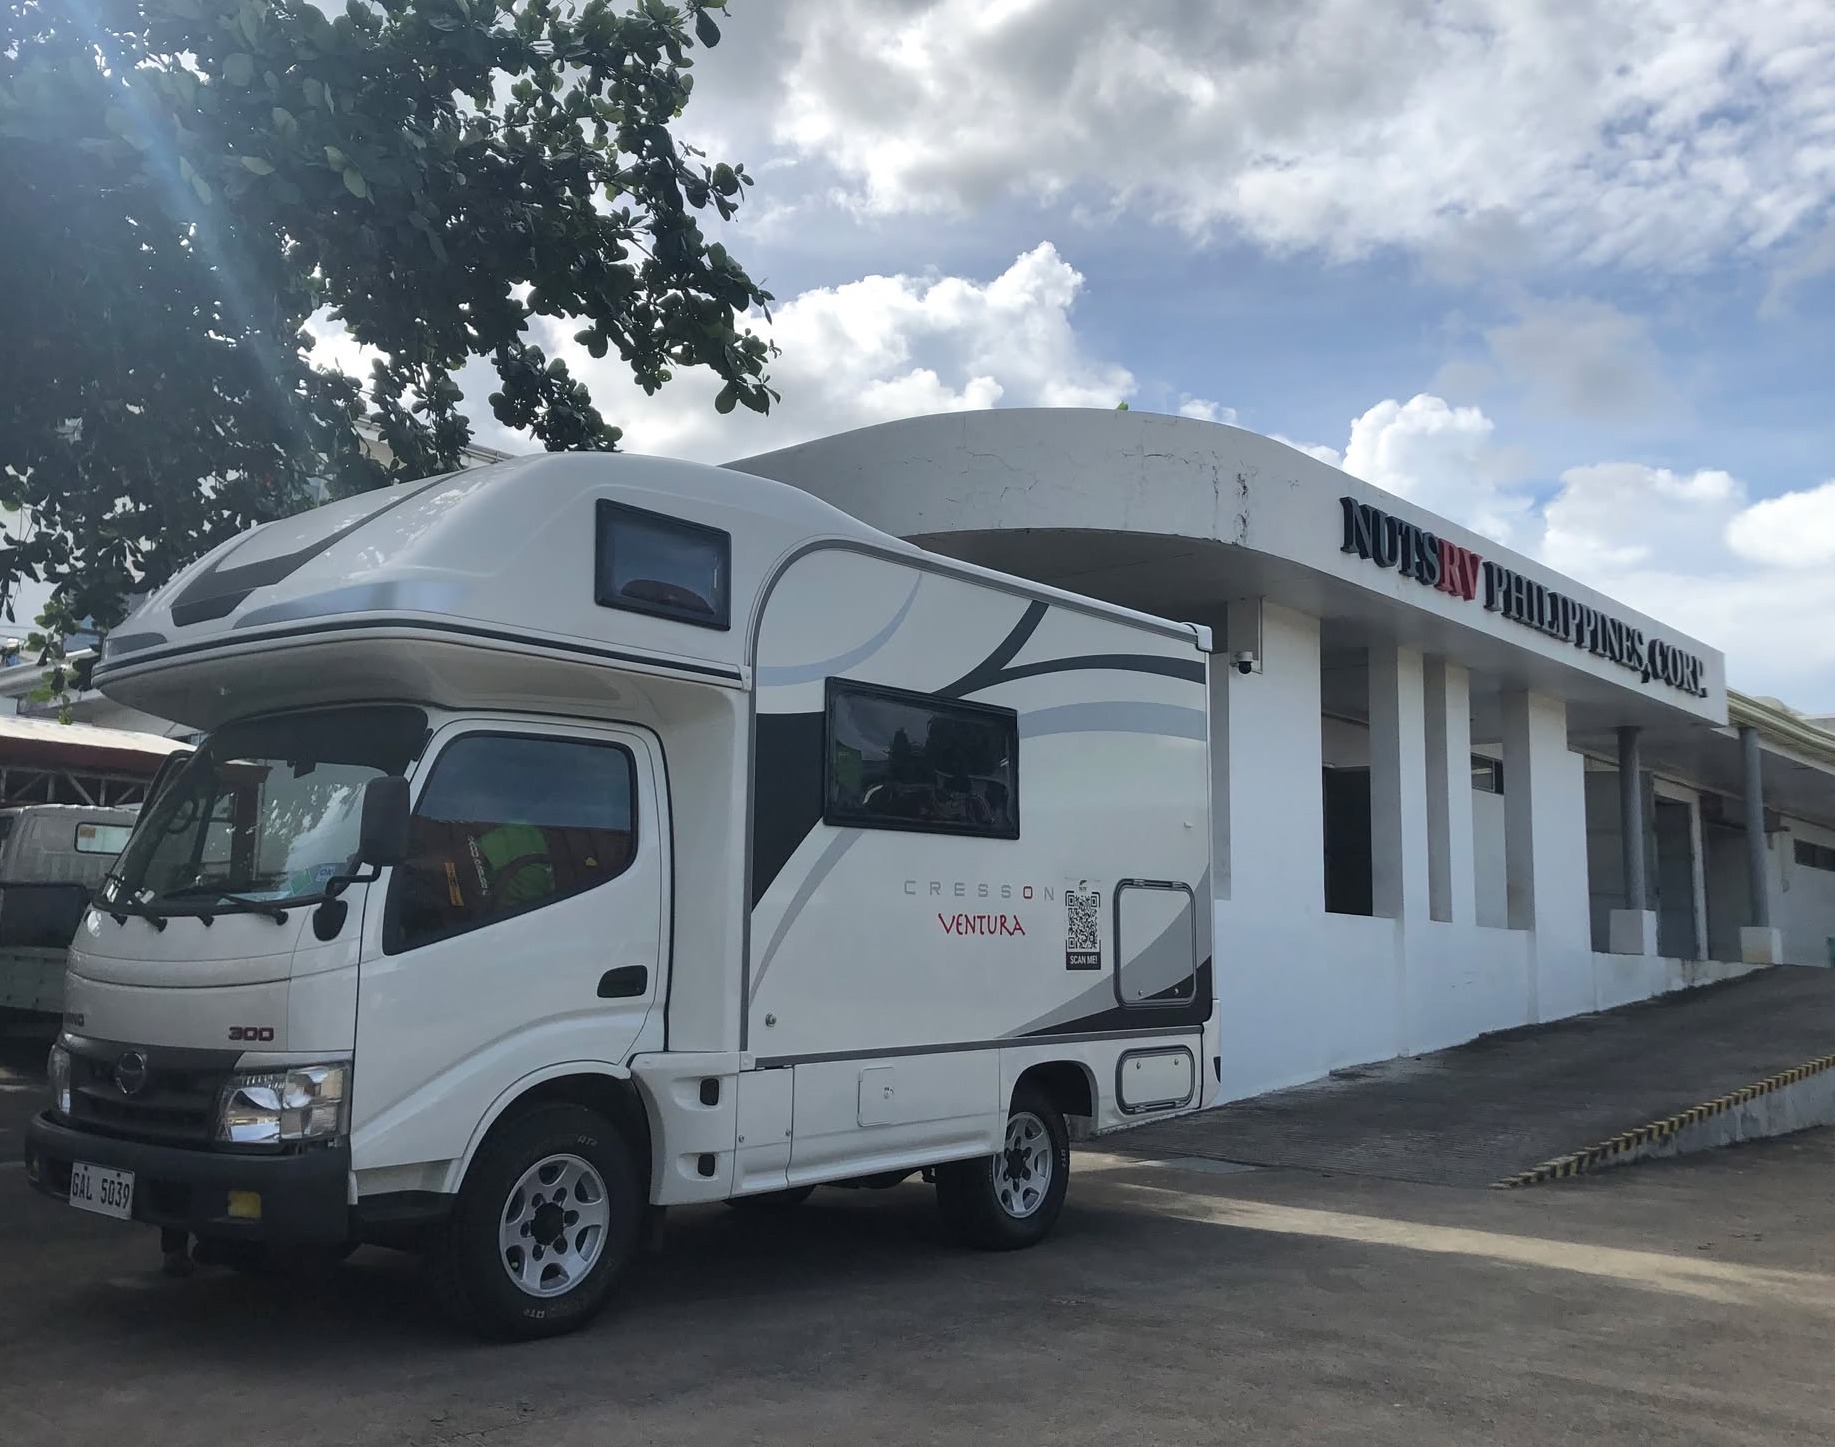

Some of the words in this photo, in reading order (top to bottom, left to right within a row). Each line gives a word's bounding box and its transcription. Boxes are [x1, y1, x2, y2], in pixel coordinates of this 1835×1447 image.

[1339, 496, 1483, 601] NUTSRV
[904, 880, 1055, 901] CRESSON
[938, 913, 1026, 936] VENTURA
[1069, 955, 1086, 964] SCAN
[1087, 956, 1098, 965] ME!
[229, 1026, 274, 1042] 300
[72, 1172, 93, 1200] GAL
[100, 1177, 130, 1209] 5039
